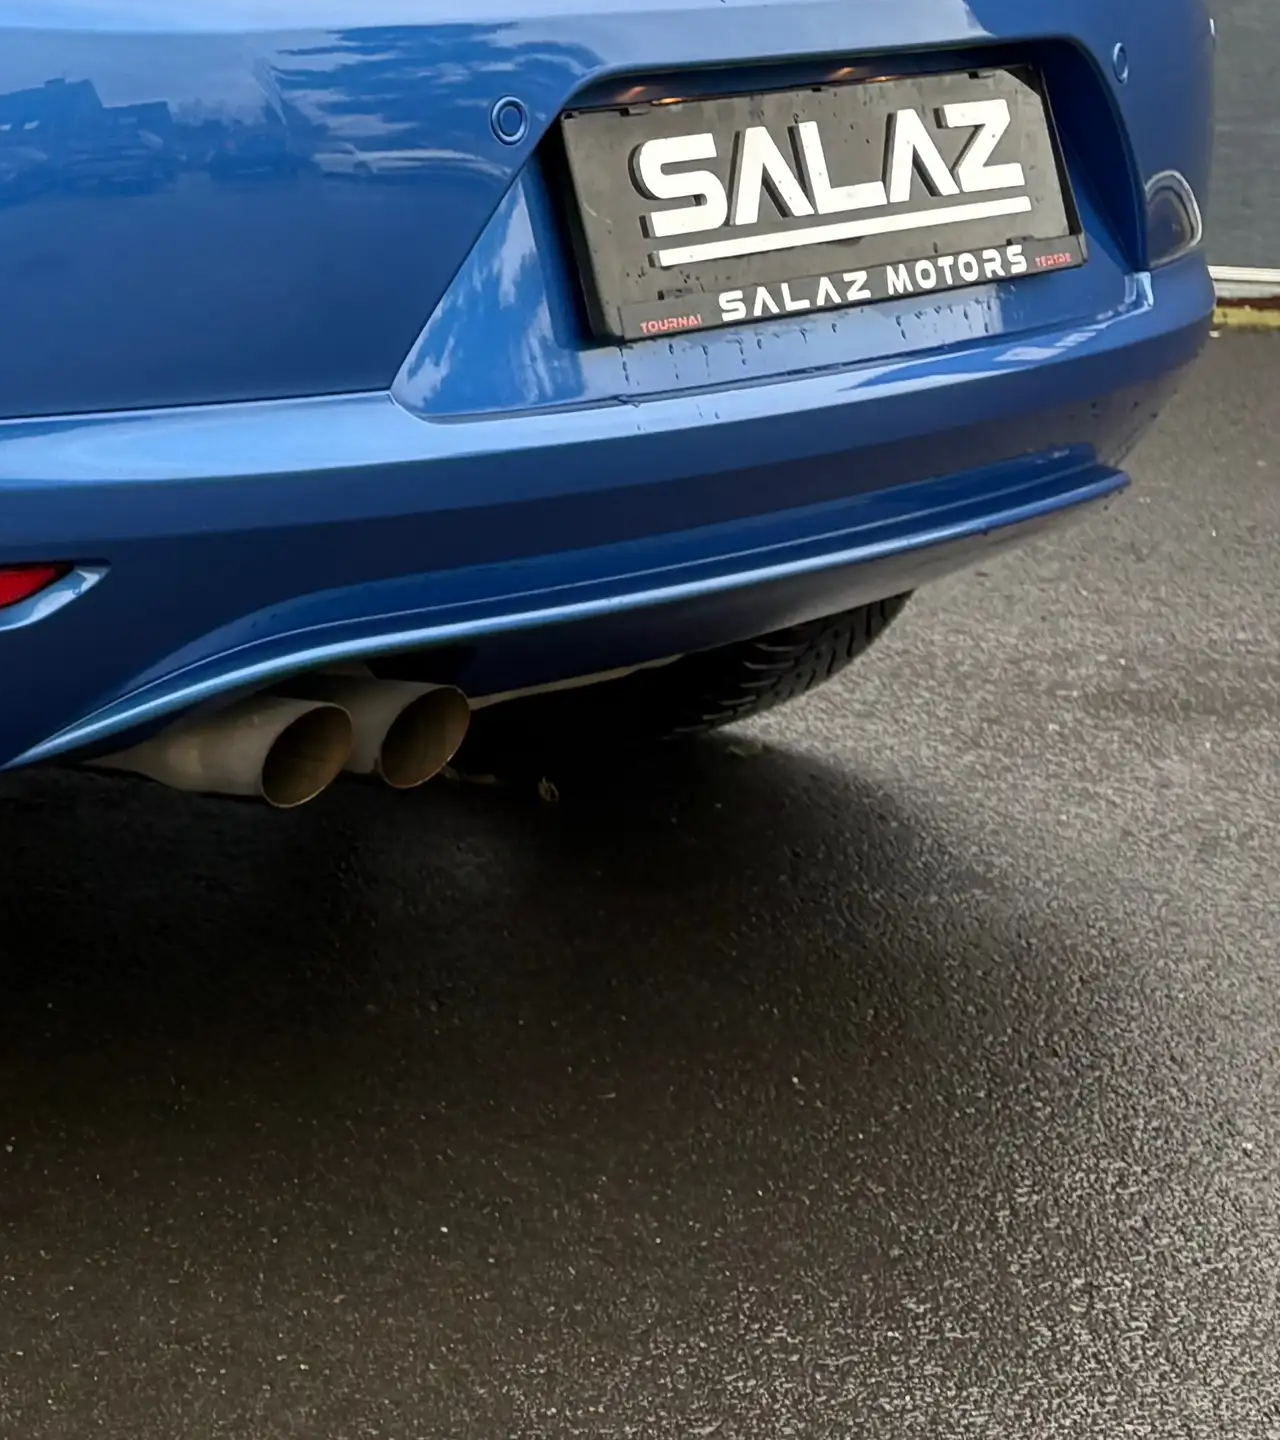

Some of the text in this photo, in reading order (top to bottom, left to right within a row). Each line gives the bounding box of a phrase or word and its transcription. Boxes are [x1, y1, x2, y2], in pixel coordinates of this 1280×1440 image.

[639, 98, 1026, 238] SALAZ
[640, 314, 703, 334] TOURNAI
[718, 271, 871, 322] SALAZ
[887, 245, 1028, 296] MOTORS
